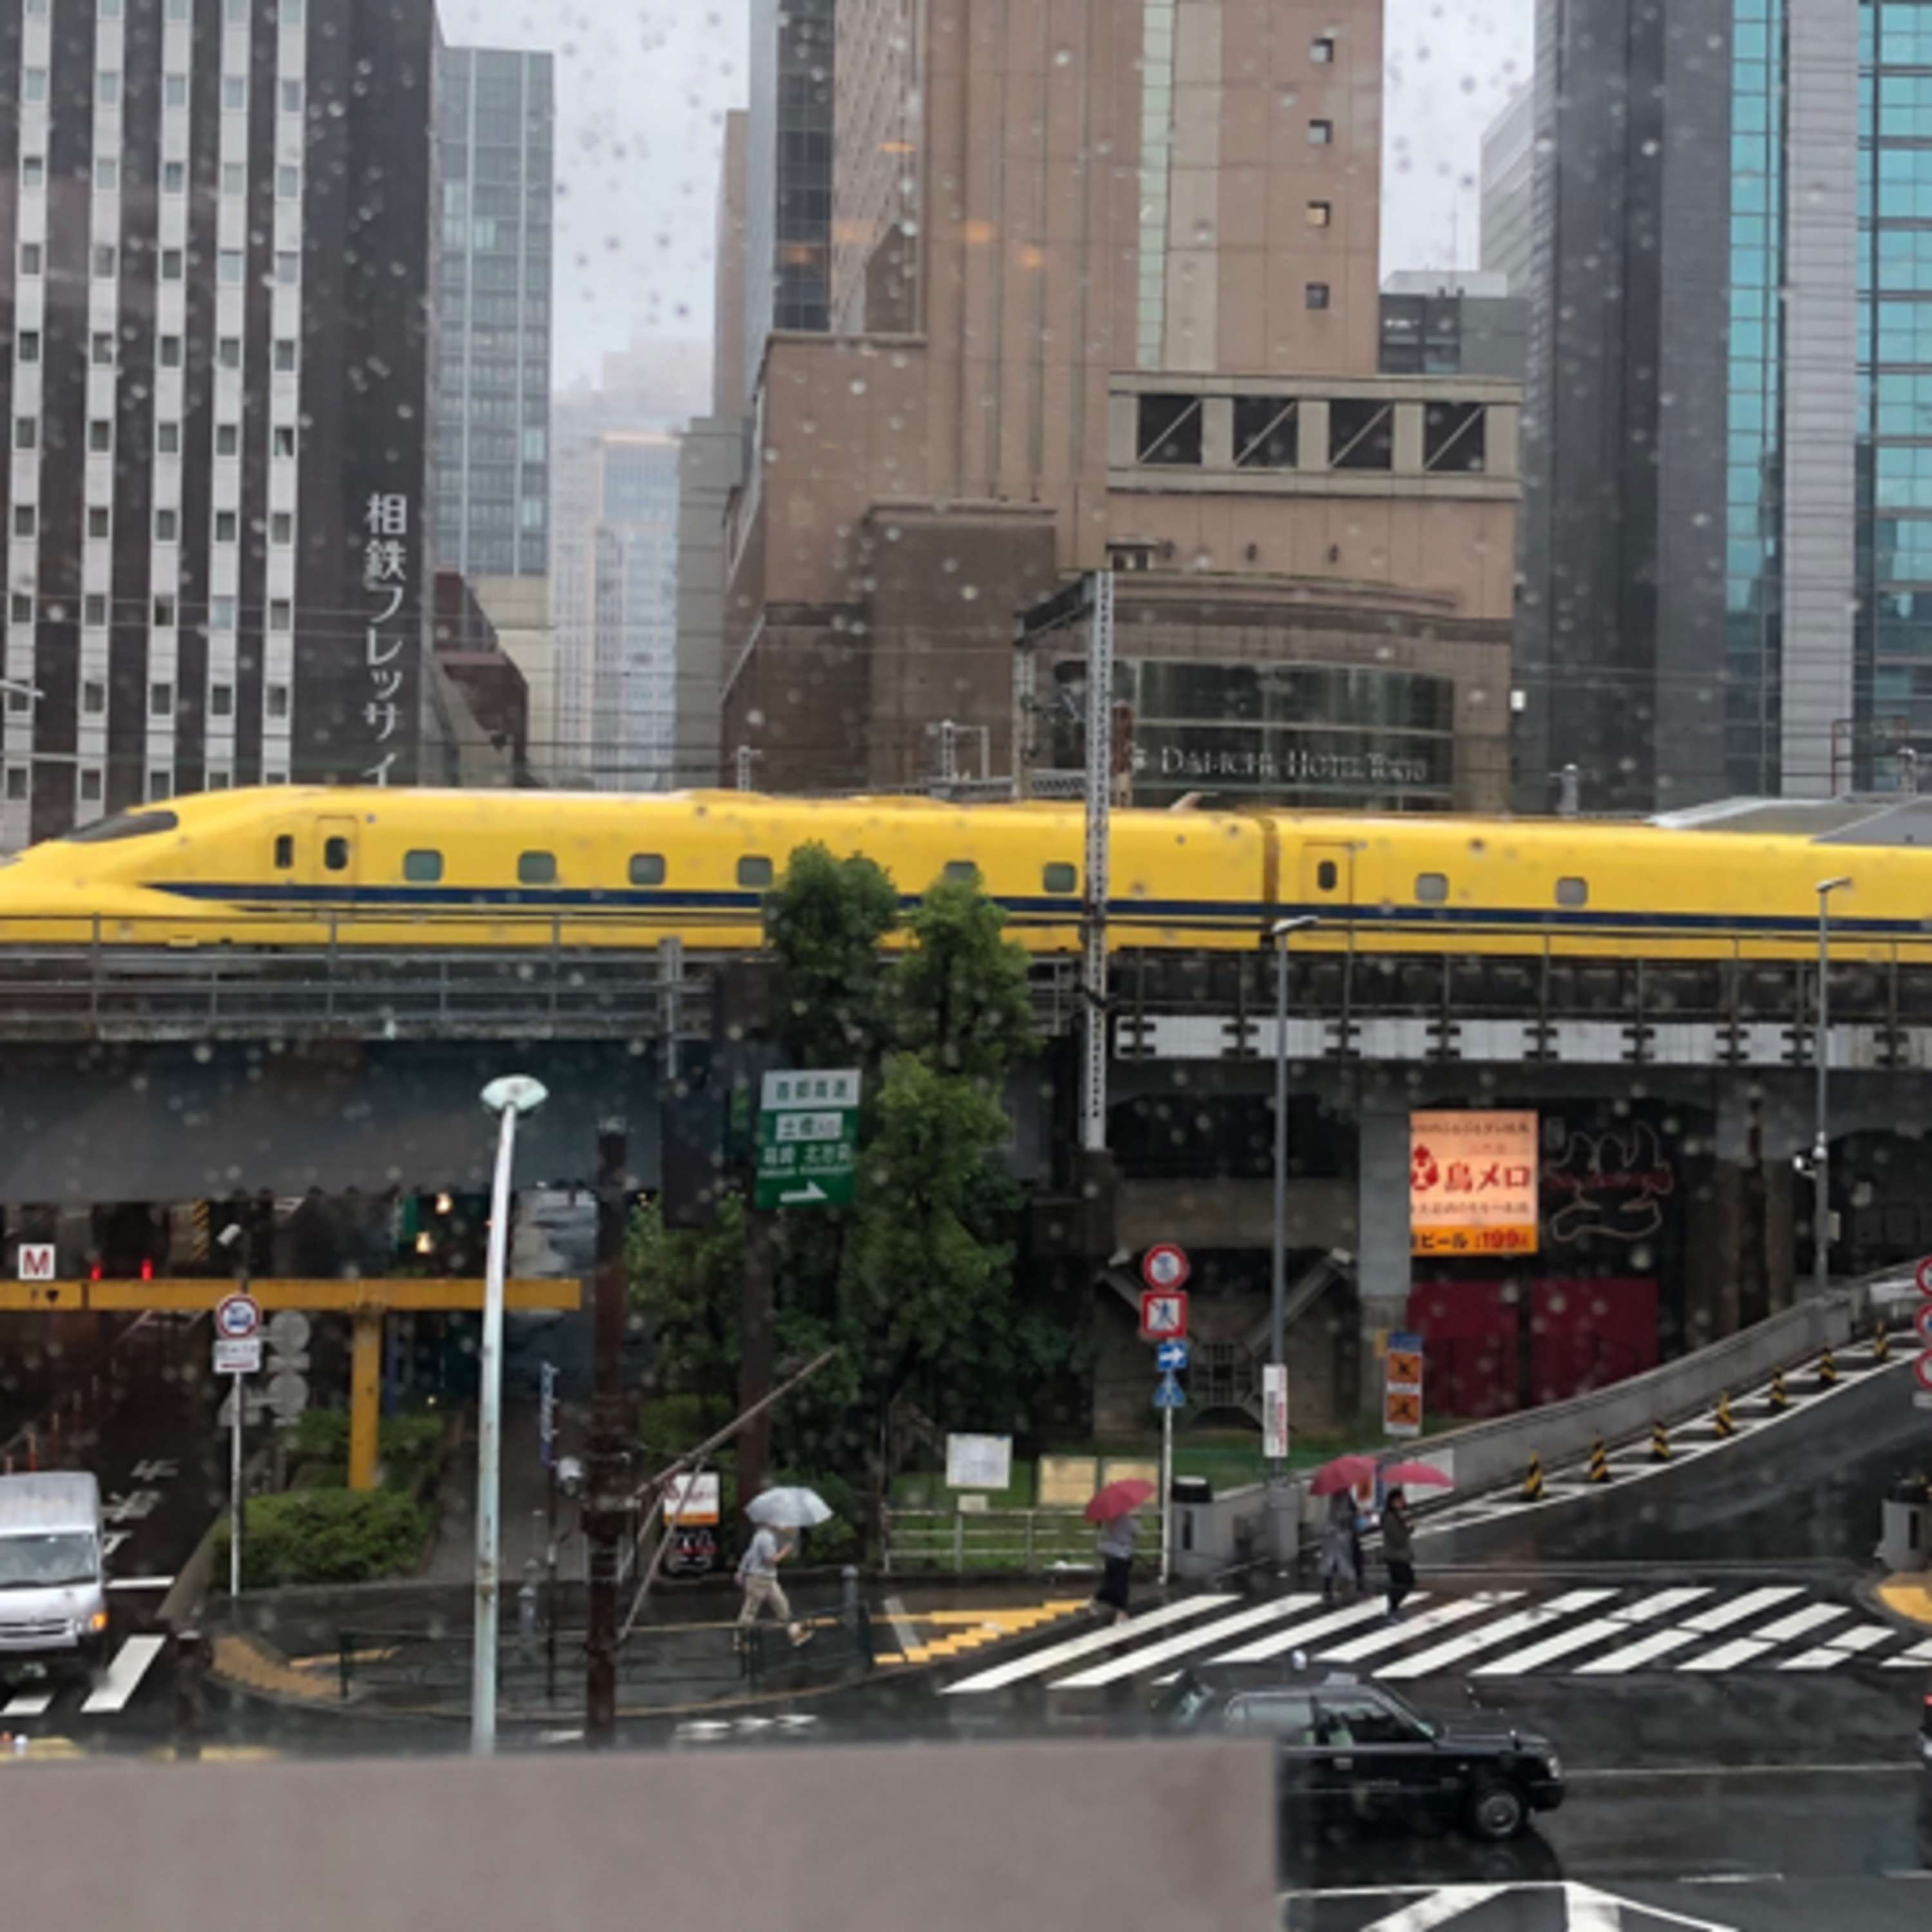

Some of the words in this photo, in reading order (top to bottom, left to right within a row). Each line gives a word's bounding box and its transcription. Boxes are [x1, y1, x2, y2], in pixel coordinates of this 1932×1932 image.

[362, 492, 407, 787] 相鉄フレッサイ
[23, 1247, 50, 1276] M
